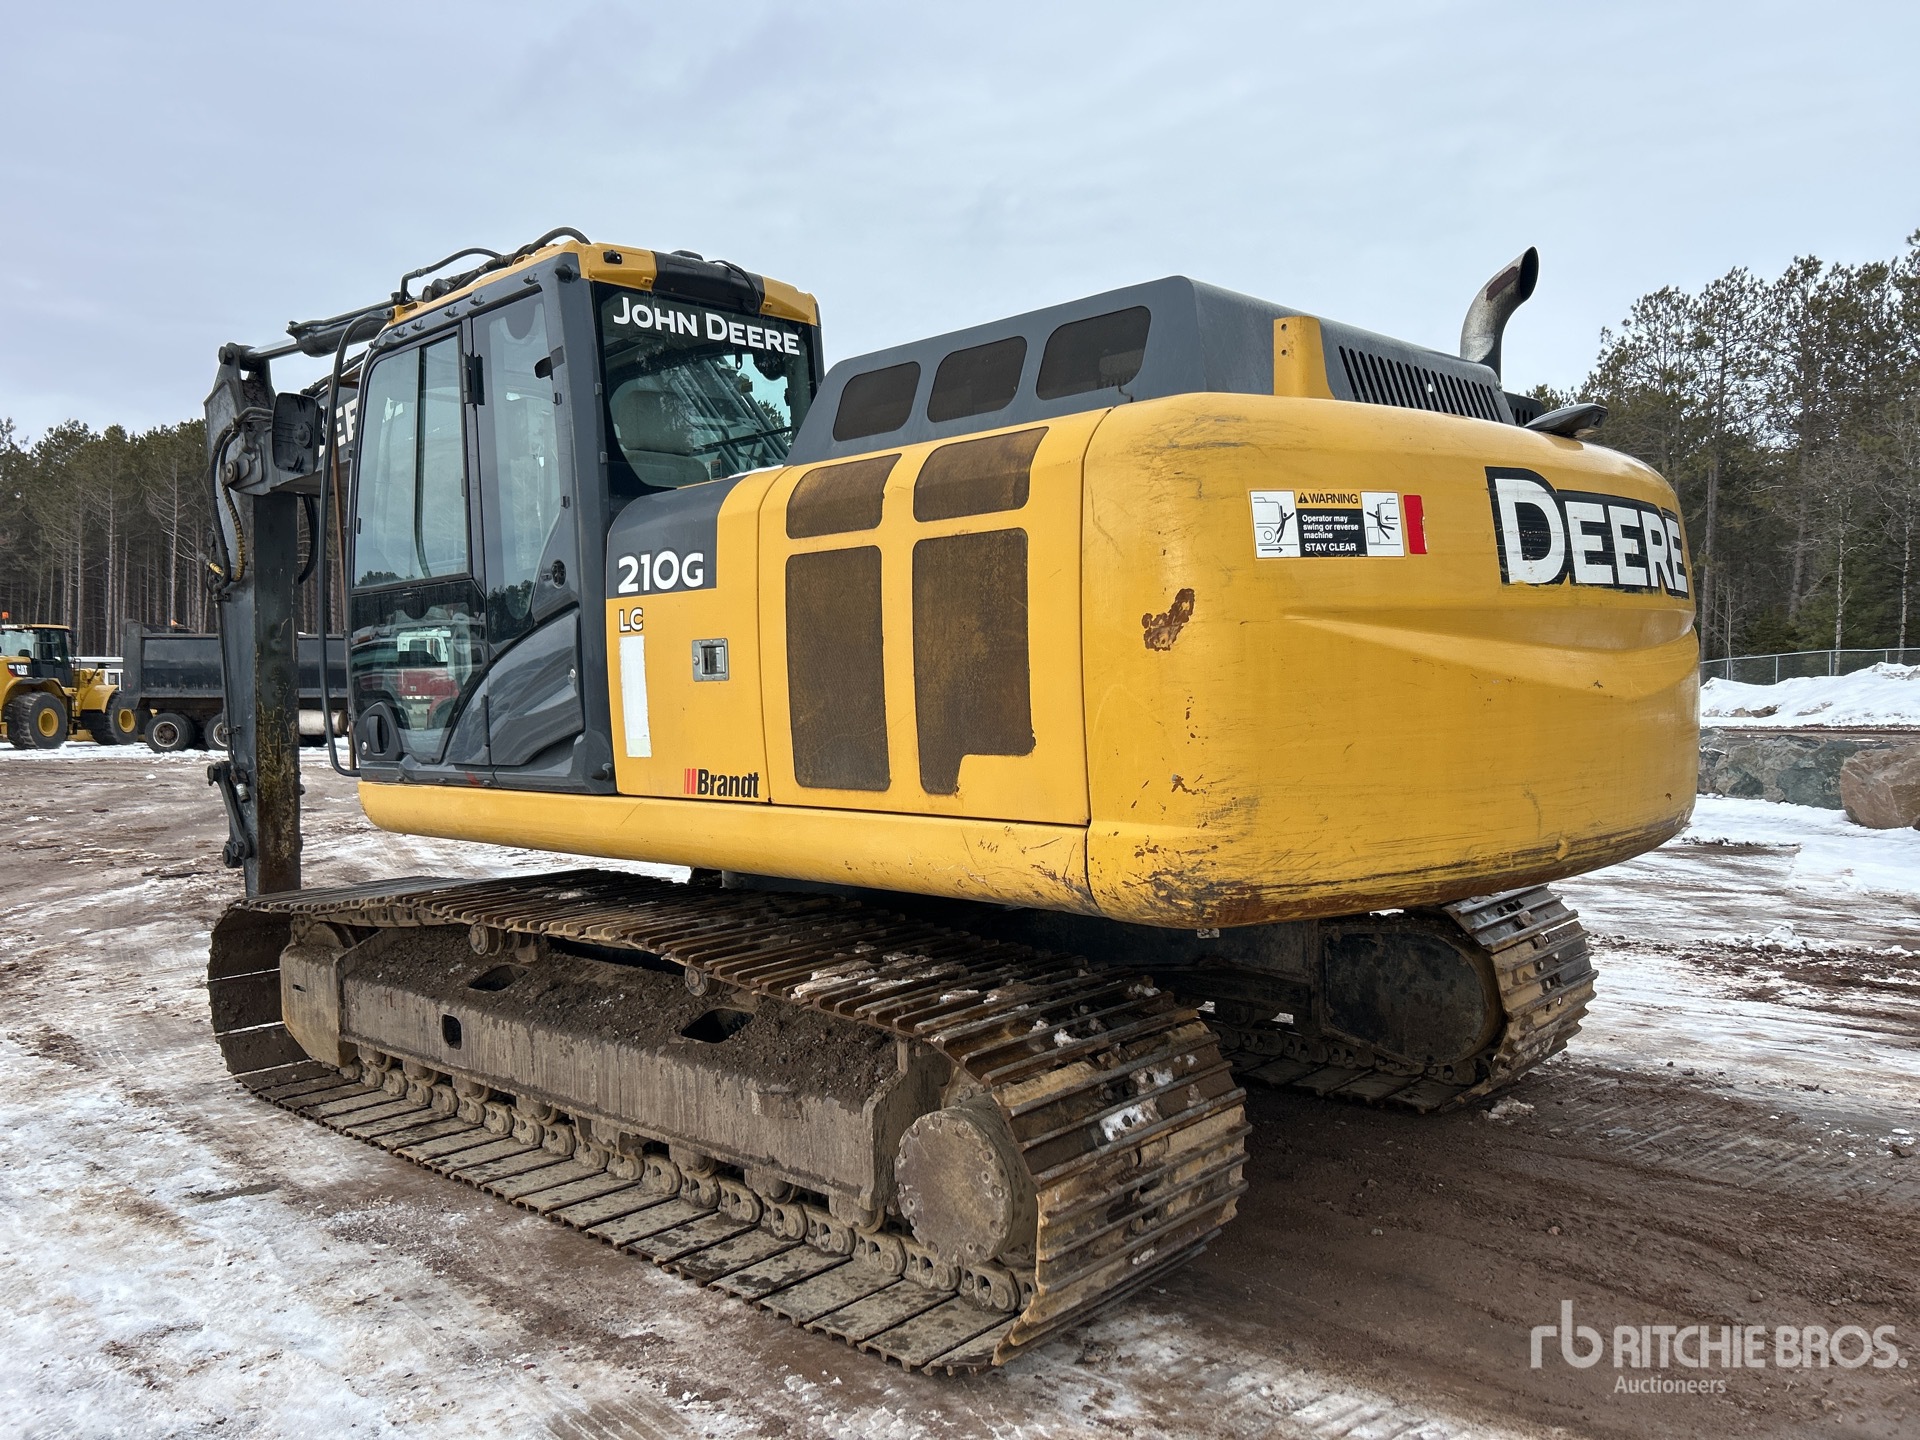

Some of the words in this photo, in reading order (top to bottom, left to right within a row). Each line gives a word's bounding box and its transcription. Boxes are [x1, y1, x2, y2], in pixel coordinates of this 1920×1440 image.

[613, 297, 698, 337] JOHN
[705, 313, 800, 355] DEERE
[1308, 493, 1358, 504] WARNING
[1302, 514, 1332, 523] Operator
[1333, 515, 1348, 523] may
[1303, 523, 1324, 532] swing
[1304, 542, 1327, 551] STAY
[1328, 542, 1357, 551] CLEAR
[1494, 477, 1688, 593] DEERE
[618, 550, 704, 594] 210G
[619, 607, 643, 633] LC
[697, 768, 759, 798] Brandt
